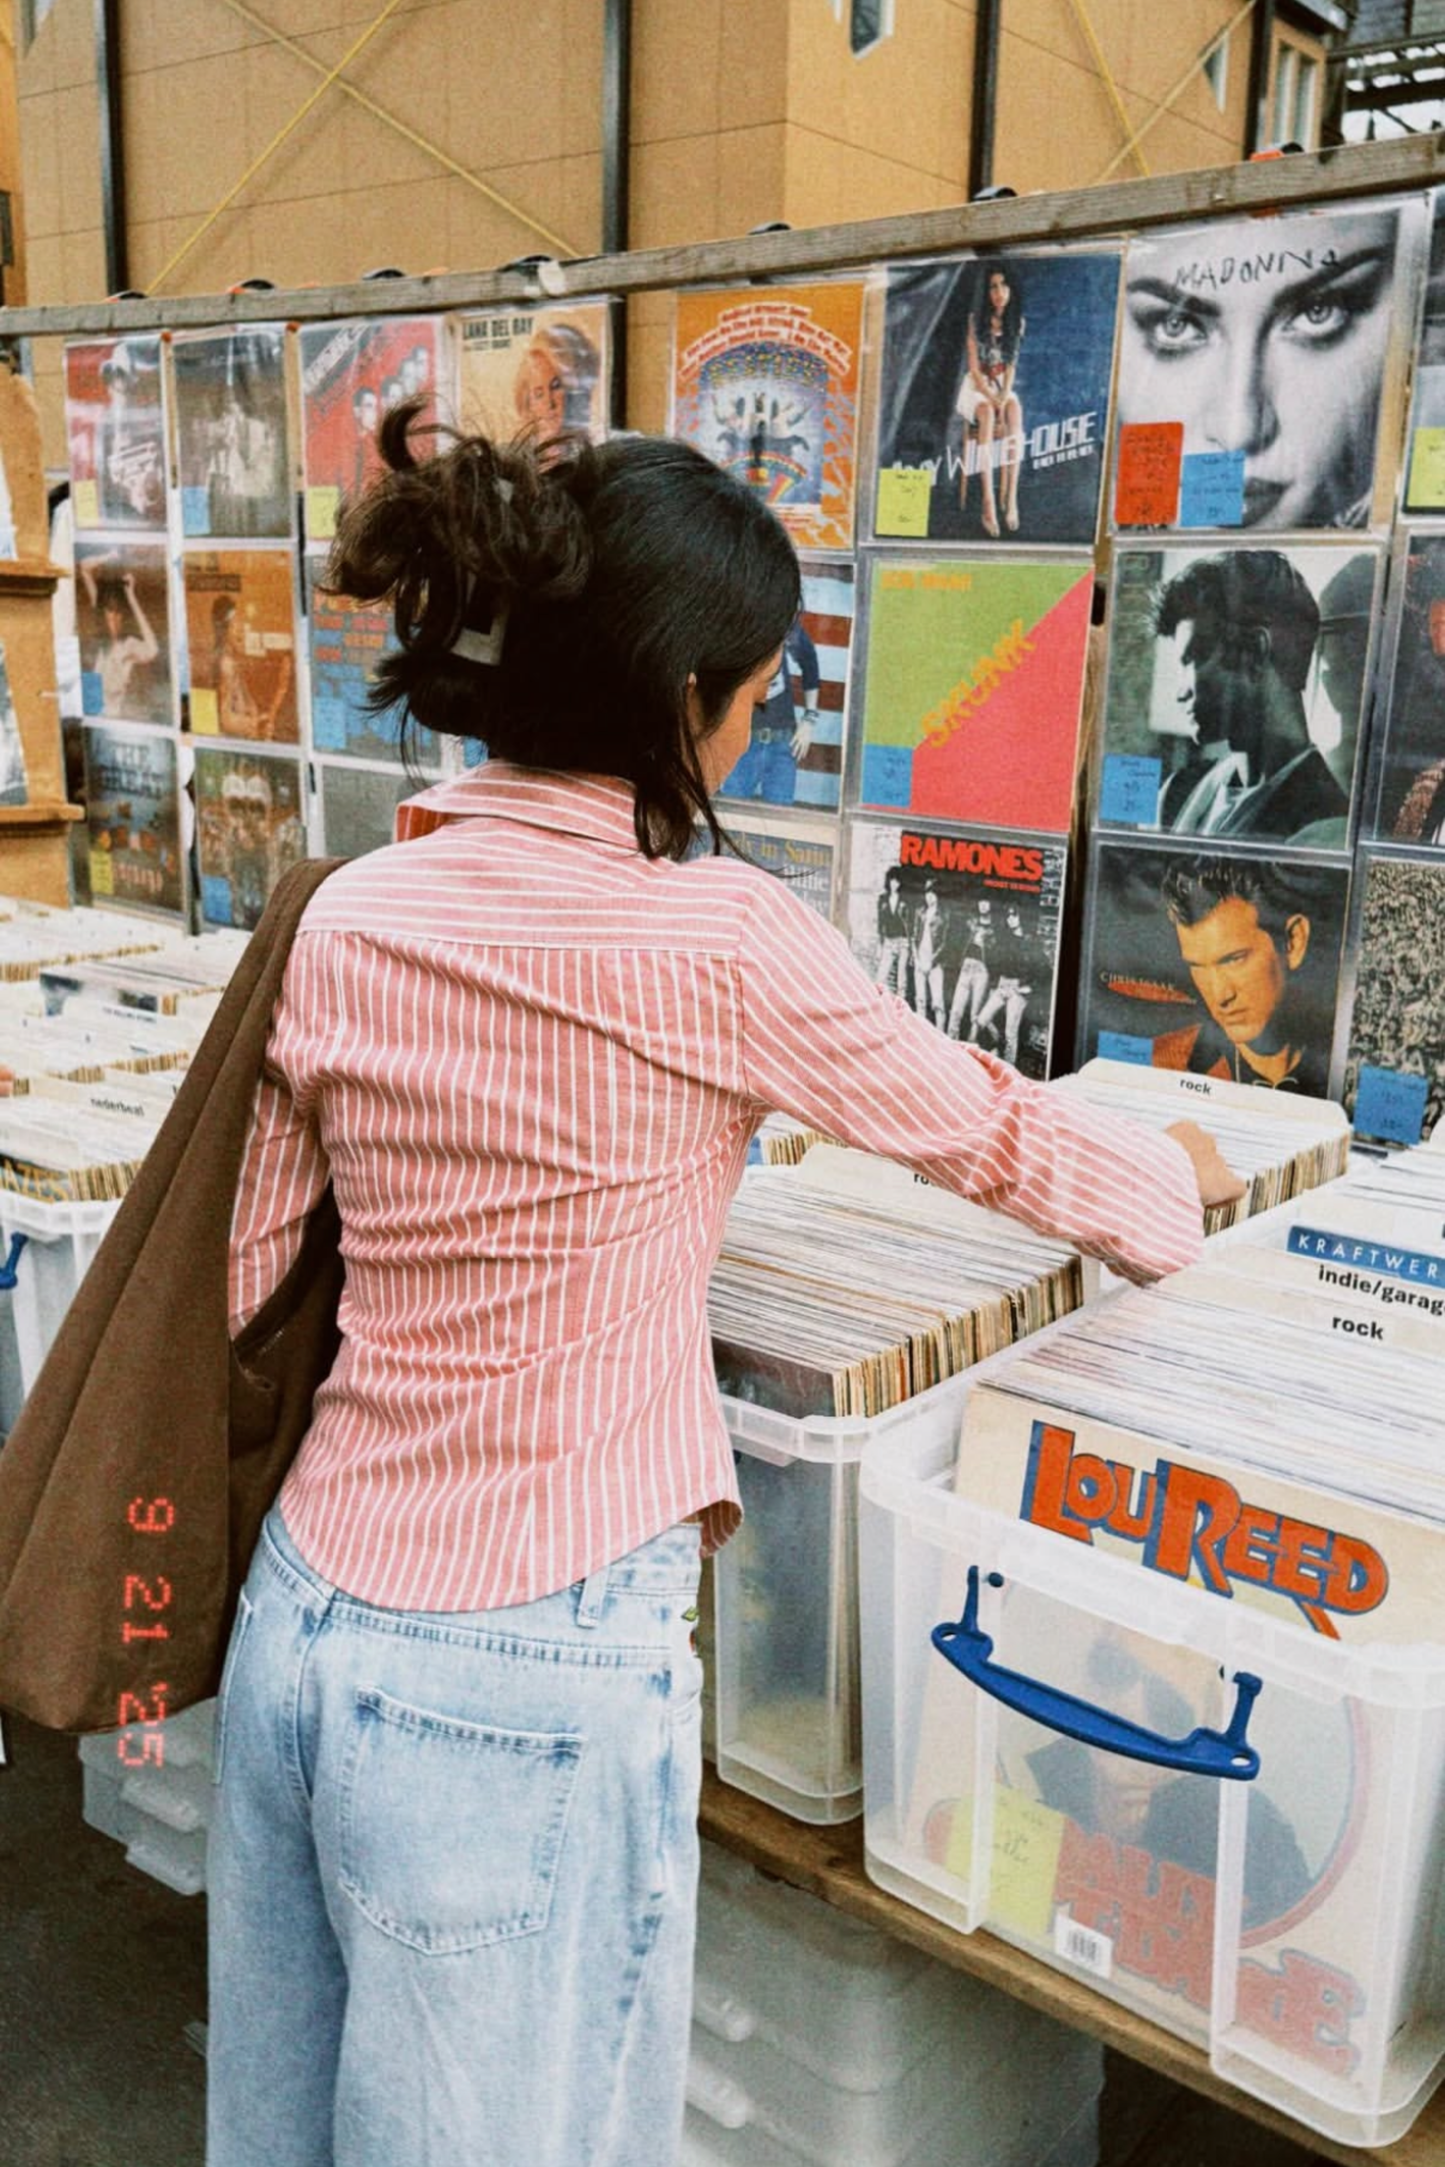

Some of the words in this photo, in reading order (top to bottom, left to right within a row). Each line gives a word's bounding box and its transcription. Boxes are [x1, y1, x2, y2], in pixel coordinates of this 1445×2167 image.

[492, 319, 509, 337] DEL
[945, 411, 1099, 481] WINEHOUSE
[900, 834, 1043, 882] RAMONES
[1180, 1079, 1211, 1095] rock
[0, 1158, 69, 1206] AZES
[1298, 1235, 1438, 1279] KRAFTWER
[1318, 1264, 1445, 1317] indie/garag
[1332, 1316, 1384, 1340] rock
